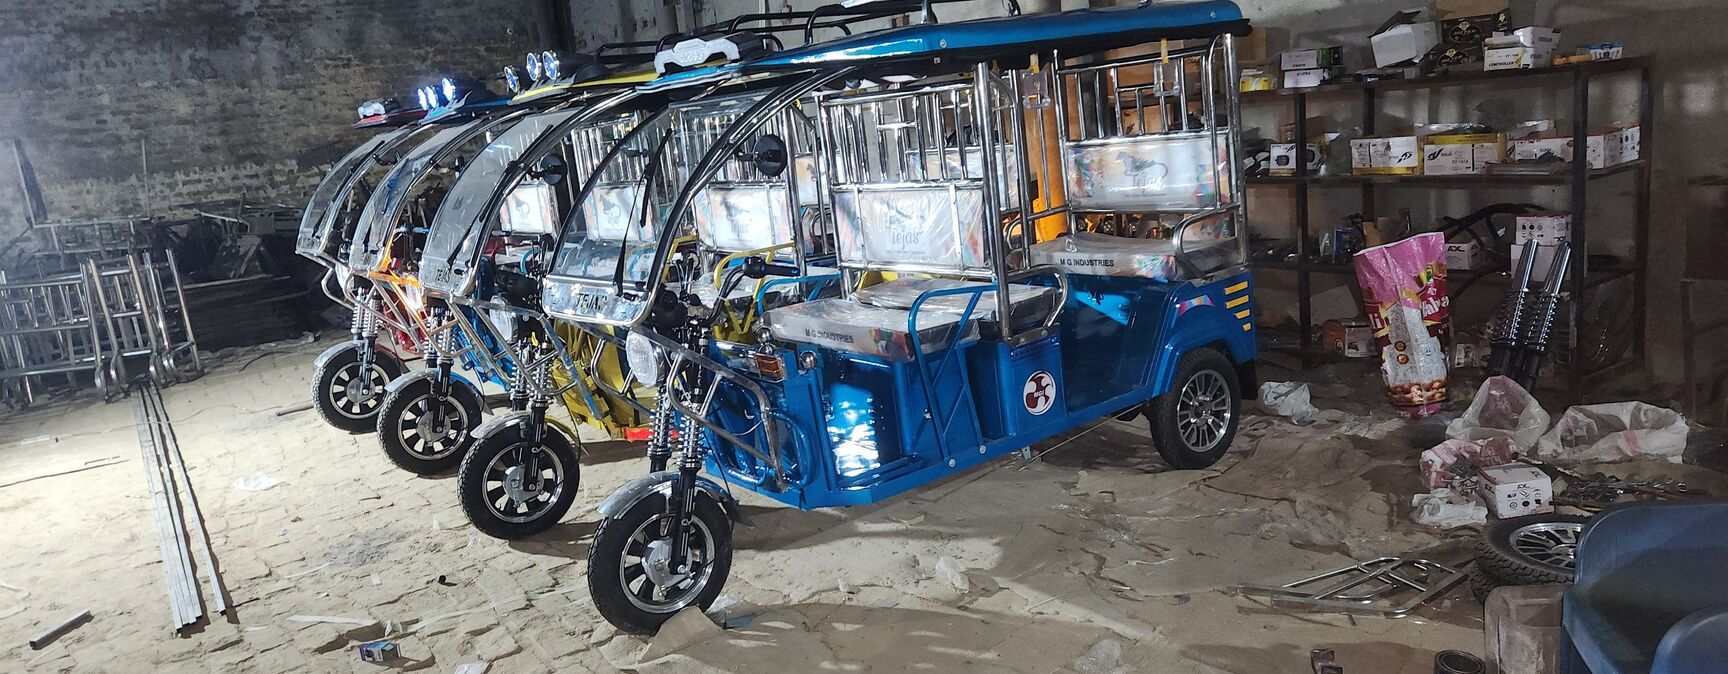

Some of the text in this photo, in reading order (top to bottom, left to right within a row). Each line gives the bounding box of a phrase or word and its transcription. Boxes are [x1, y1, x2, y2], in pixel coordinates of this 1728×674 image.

[1073, 259, 1114, 267] INDUSTRIES
[805, 328, 811, 336] M
[817, 330, 855, 343] INDUSTRIES
